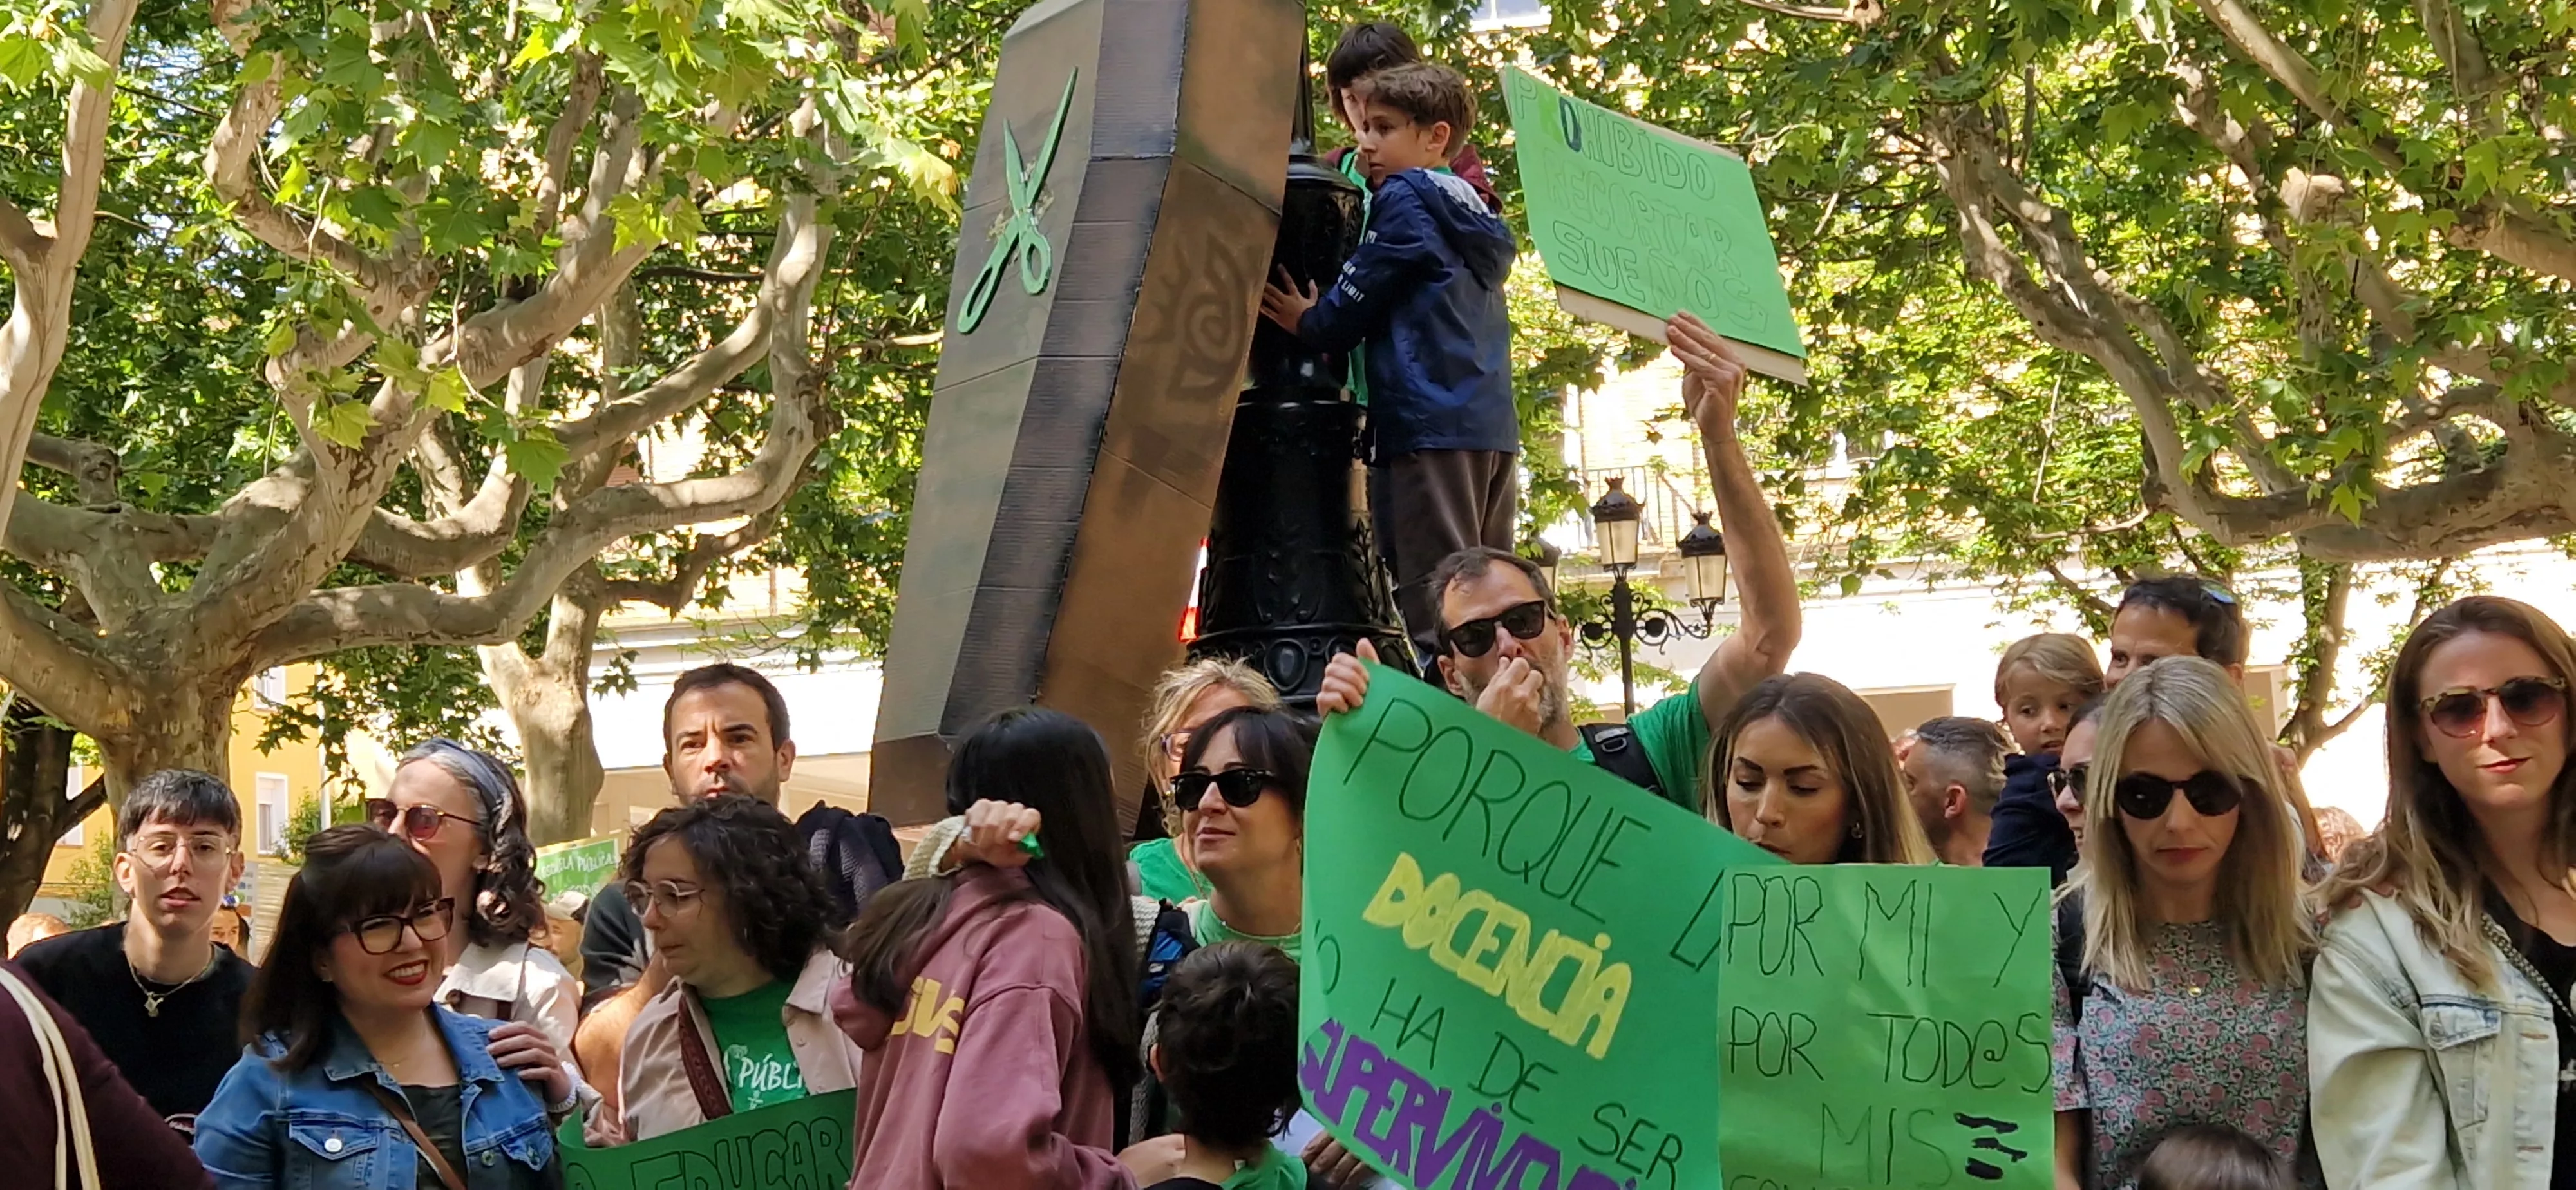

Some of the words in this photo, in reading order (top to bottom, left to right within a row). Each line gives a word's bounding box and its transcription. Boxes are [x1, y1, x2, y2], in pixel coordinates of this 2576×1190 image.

[1343, 697, 1651, 924] PORQUE
[1362, 851, 1632, 1060] DOCENCIA
[1727, 873, 1824, 977] POR
[1859, 879, 1932, 988] MI
[1993, 887, 2043, 988] Y
[1370, 976, 1444, 1070] HA
[1468, 1030, 1558, 1124] DE
[1577, 1102, 1684, 1190] SER
[1727, 1006, 1824, 1081] POR
[1866, 1012, 2052, 1095] TOD@S
[1819, 1102, 1953, 1188] MIS
